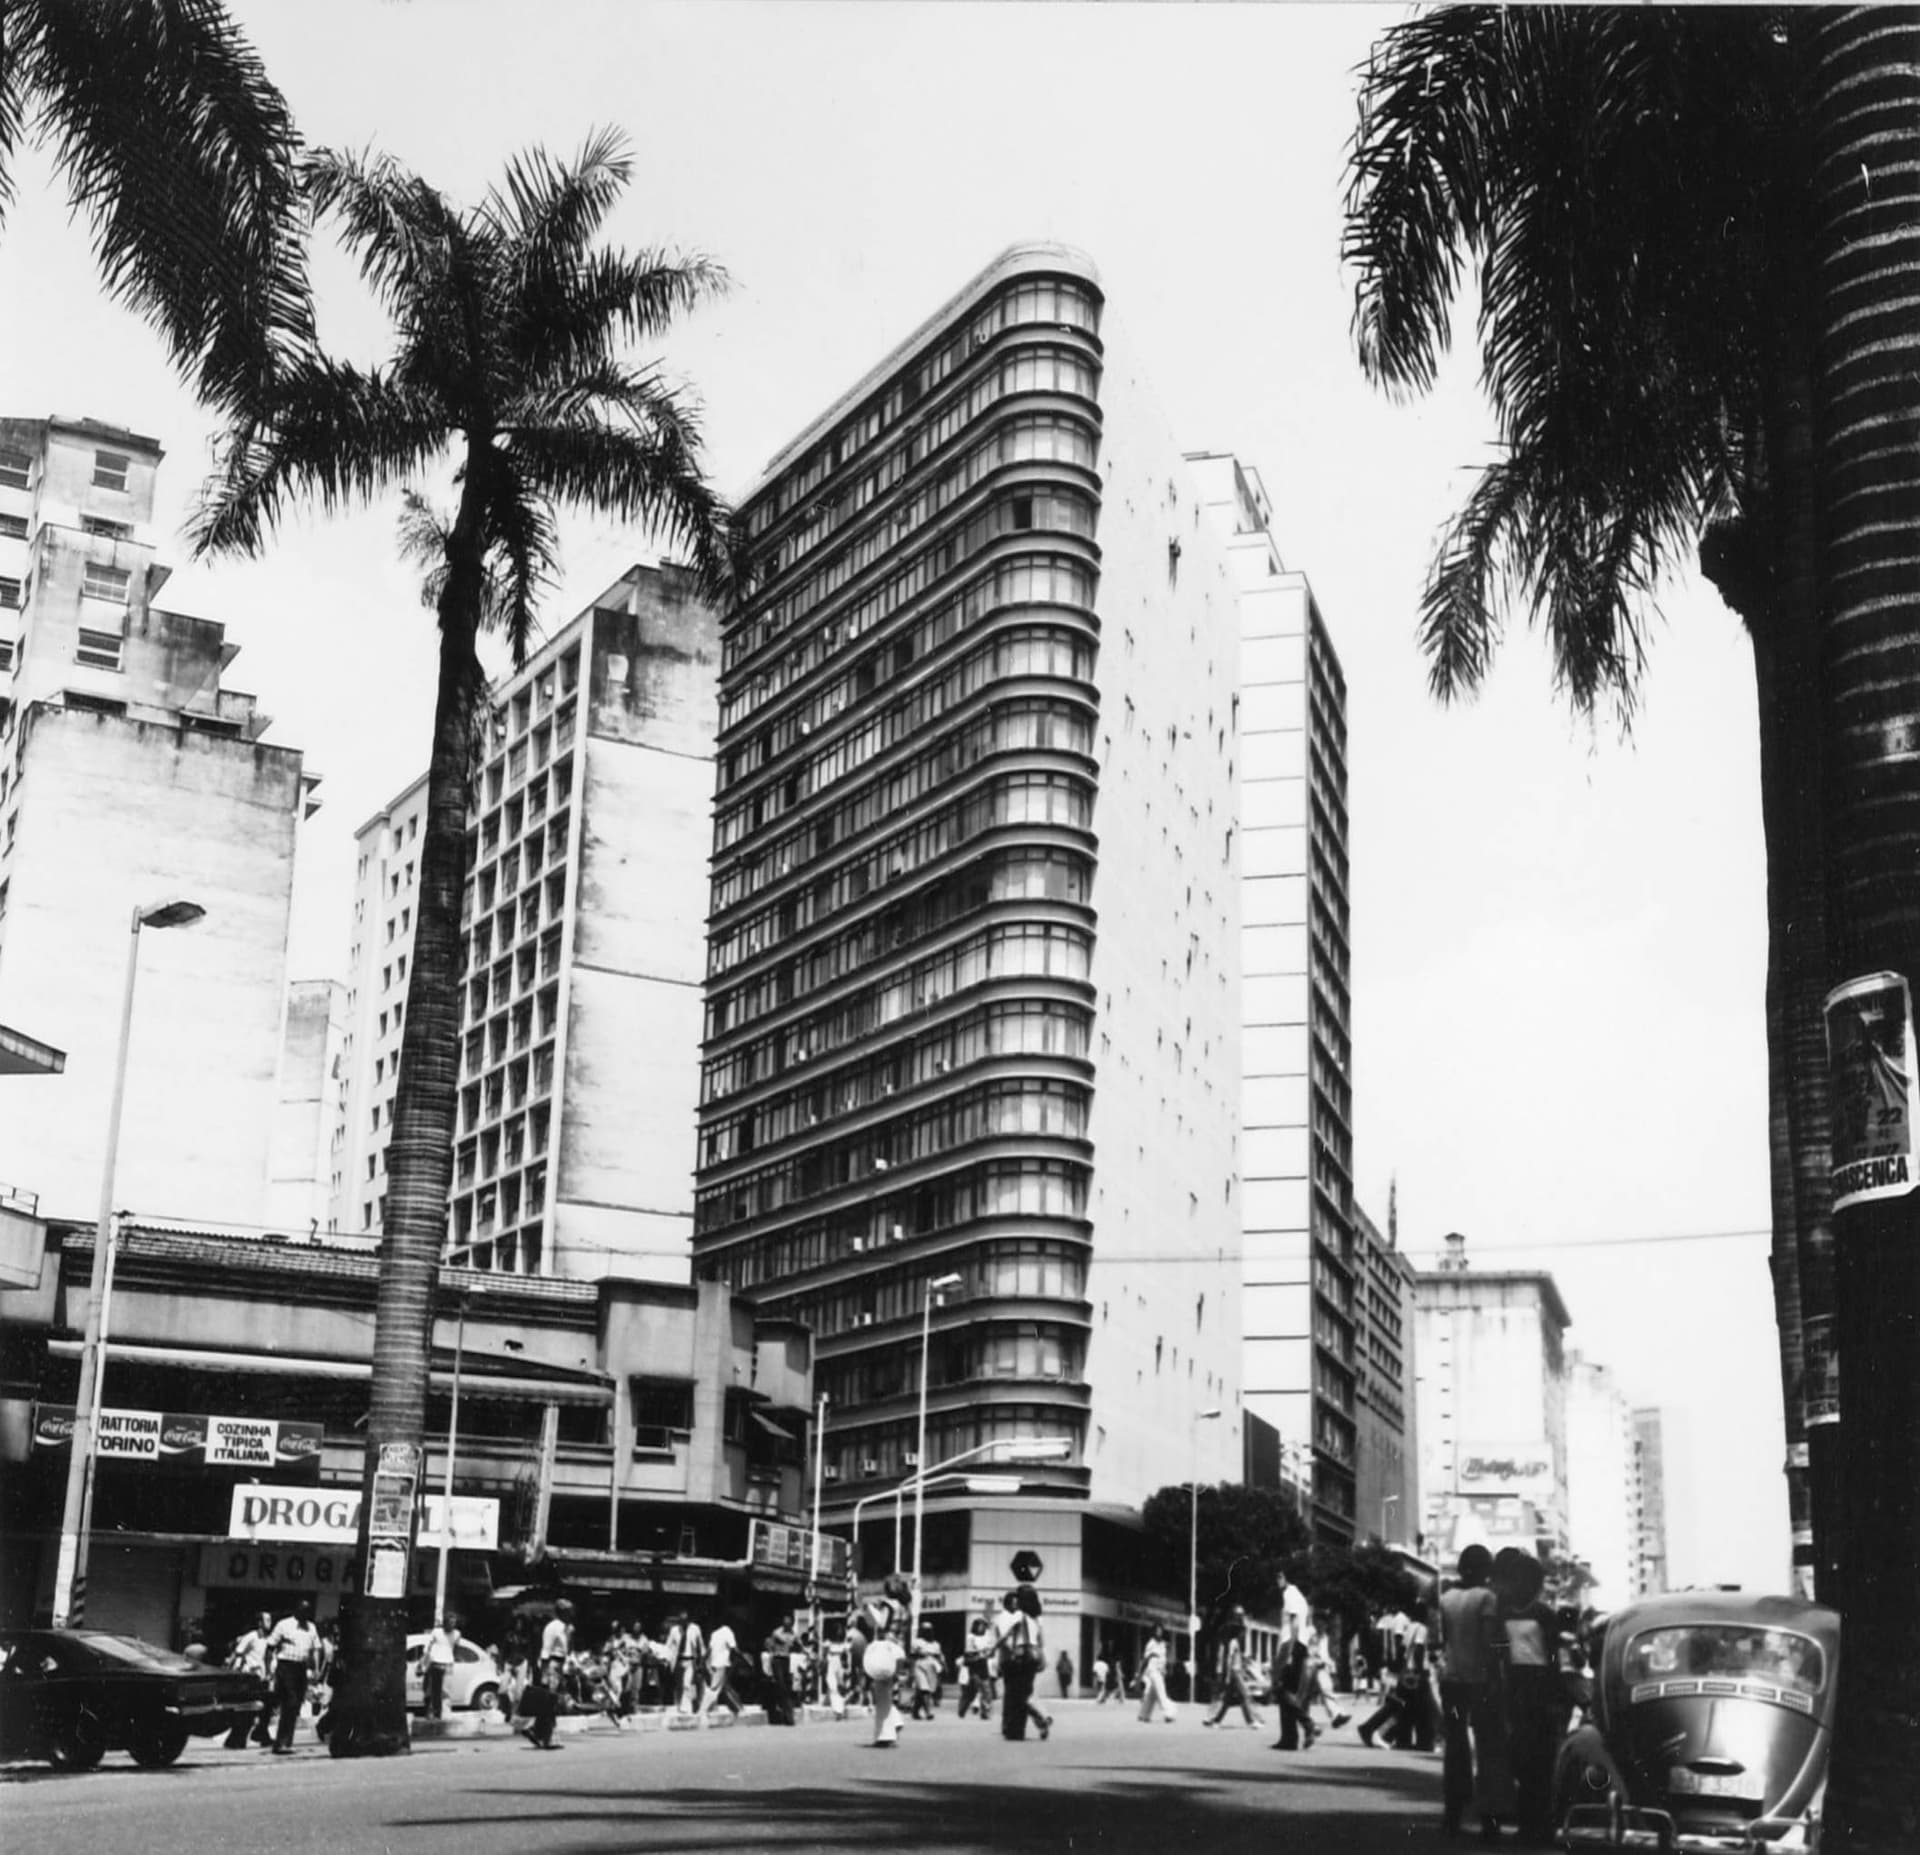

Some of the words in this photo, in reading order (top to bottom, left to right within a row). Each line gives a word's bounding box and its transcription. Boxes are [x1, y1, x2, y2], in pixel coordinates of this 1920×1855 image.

[1877, 1107, 1902, 1125] 22
[99, 1415, 159, 1434] RATTORIA
[216, 1423, 272, 1437] COZINHA
[223, 1436, 264, 1448] TIPICA
[214, 1448, 270, 1462] ITALIANA
